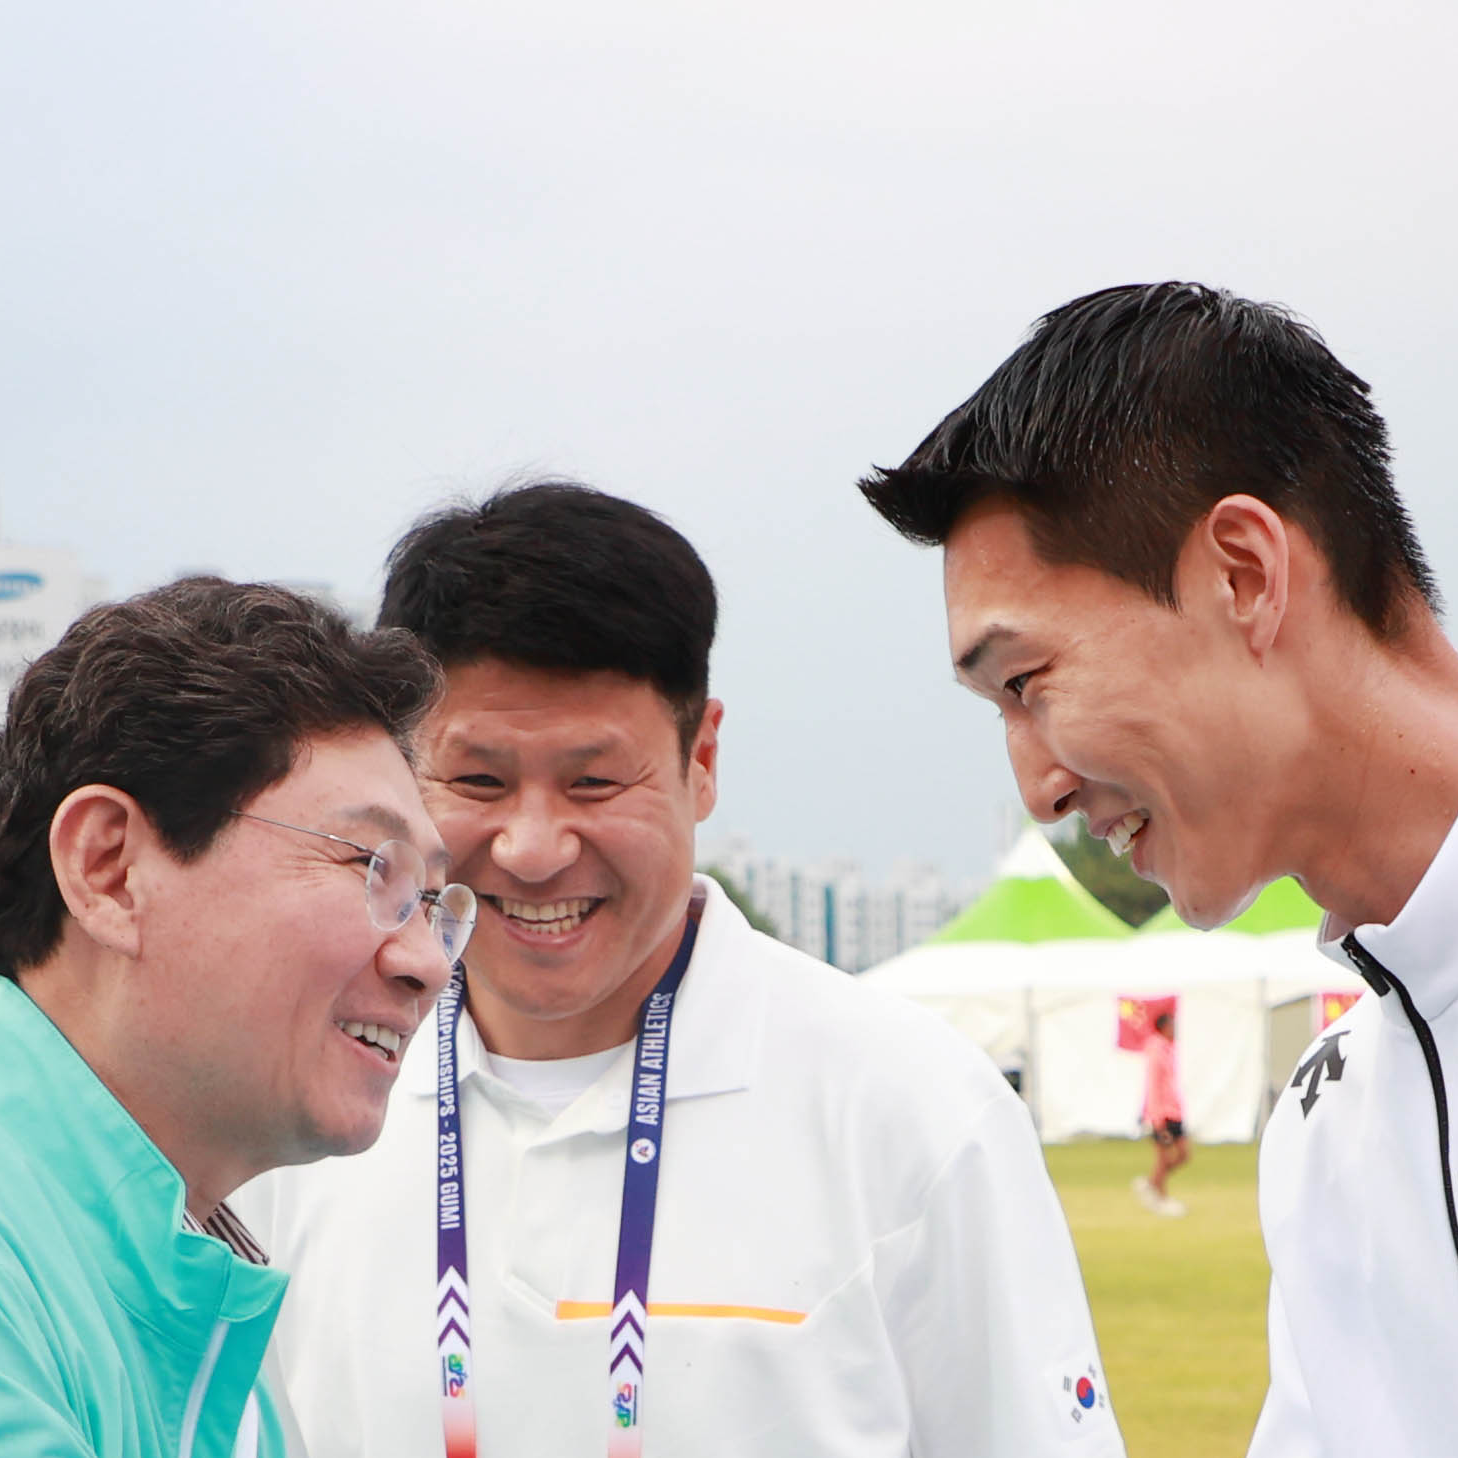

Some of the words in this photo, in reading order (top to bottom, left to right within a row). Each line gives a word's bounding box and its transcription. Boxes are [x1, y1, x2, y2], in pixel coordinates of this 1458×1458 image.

[439, 979, 463, 1117] CHAMPIONSHIPS
[640, 992, 673, 1070] ATHLETICS
[635, 1073, 662, 1126] ASIAN
[439, 1132, 459, 1178] 2025
[439, 1181, 461, 1230] GUMI
